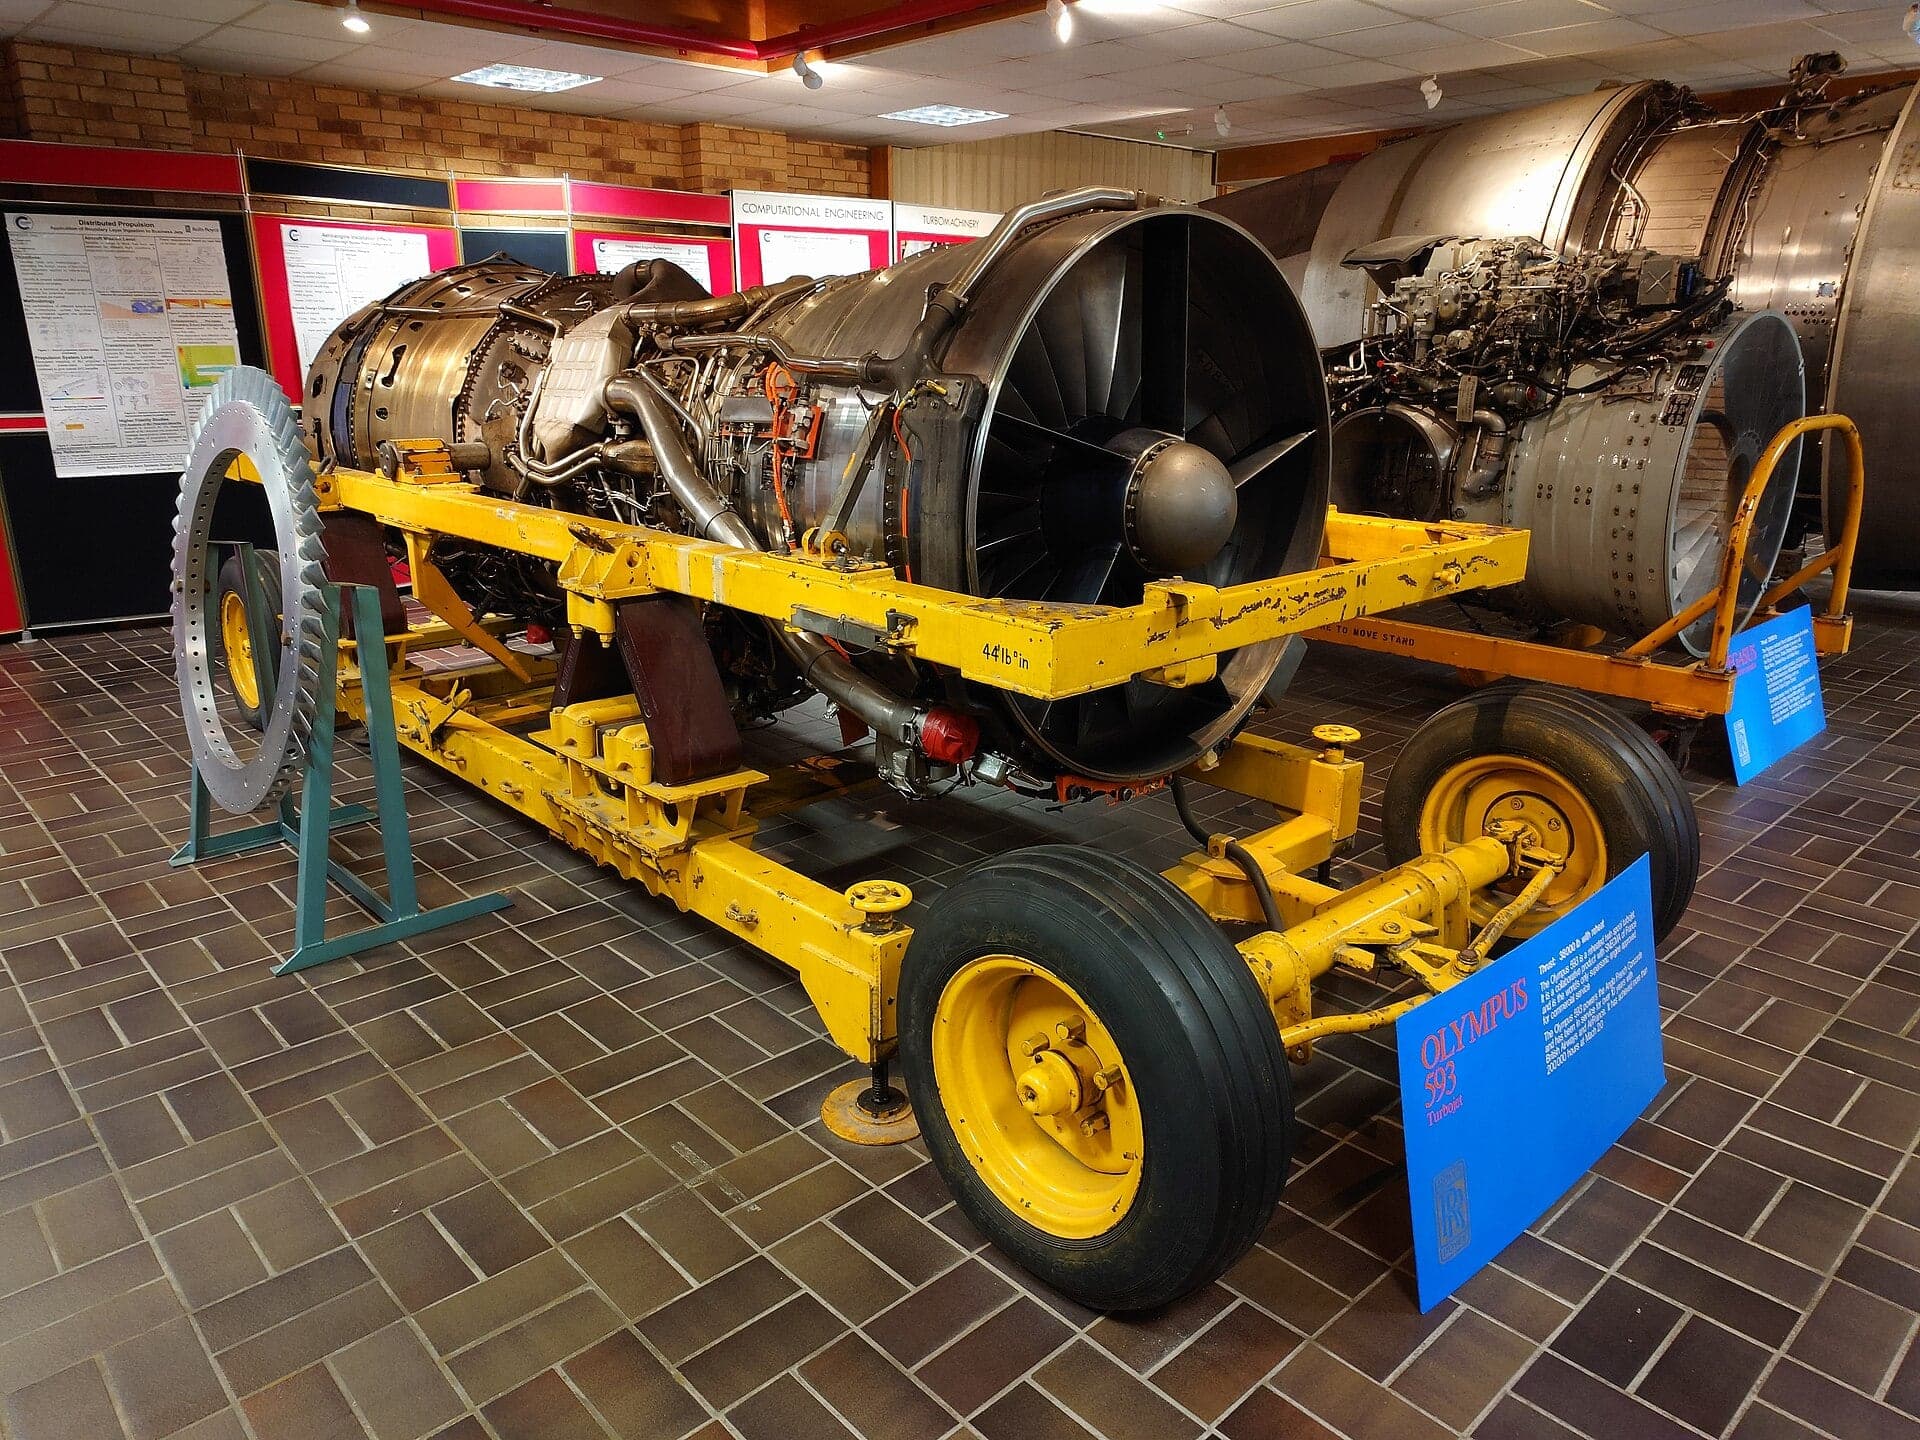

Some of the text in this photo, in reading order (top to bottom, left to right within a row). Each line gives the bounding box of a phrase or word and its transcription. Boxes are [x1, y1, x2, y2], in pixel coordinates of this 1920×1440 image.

[742, 202, 884, 221] COMPUTATIONAL ENGINEERING
[923, 214, 980, 229] TURBOMACHINERY
[78, 219, 155, 228] Distributed Propulsion
[1336, 624, 1348, 634] TO
[1353, 628, 1378, 640] MOVE
[1382, 633, 1415, 647] STAND
[1420, 977, 1529, 1070] OLYMPUS
[1424, 1060, 1457, 1109] 593
[1426, 1094, 1464, 1127] Turbojet
